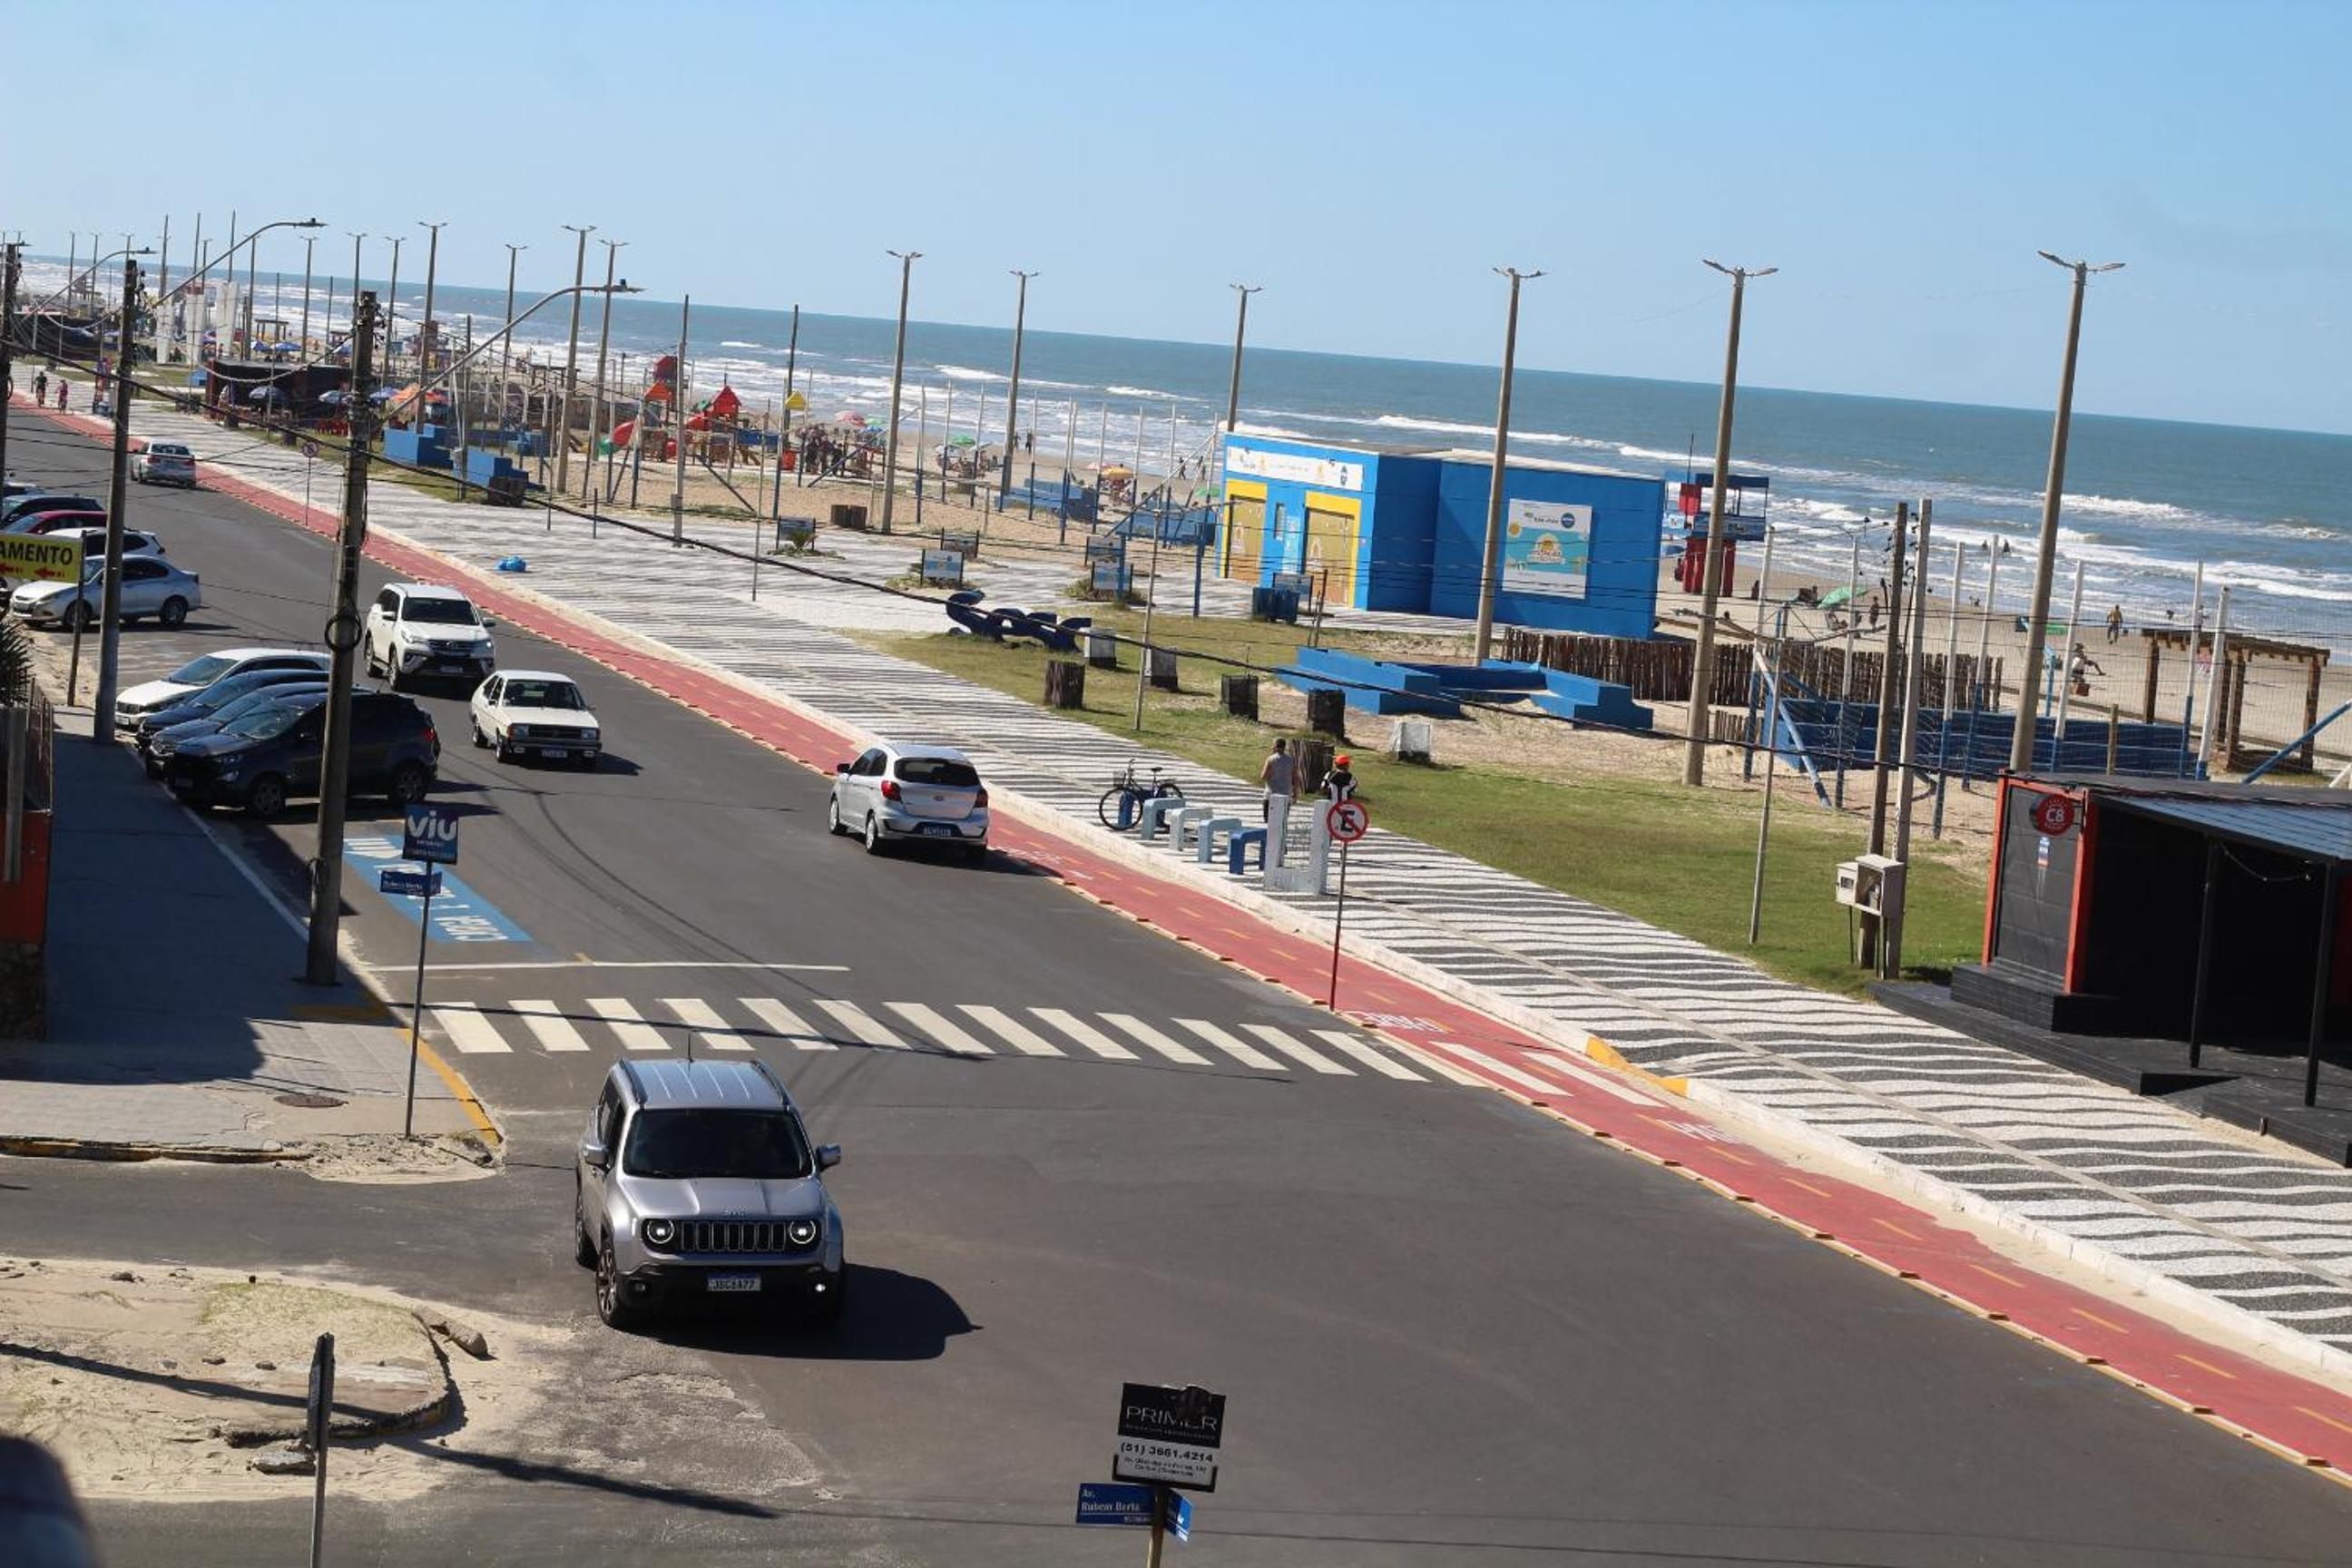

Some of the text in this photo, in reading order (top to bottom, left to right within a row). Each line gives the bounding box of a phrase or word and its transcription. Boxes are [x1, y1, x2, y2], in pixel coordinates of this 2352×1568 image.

[407, 810, 457, 841] viu
[1121, 1442, 1213, 1462] (51) 3661.4214
